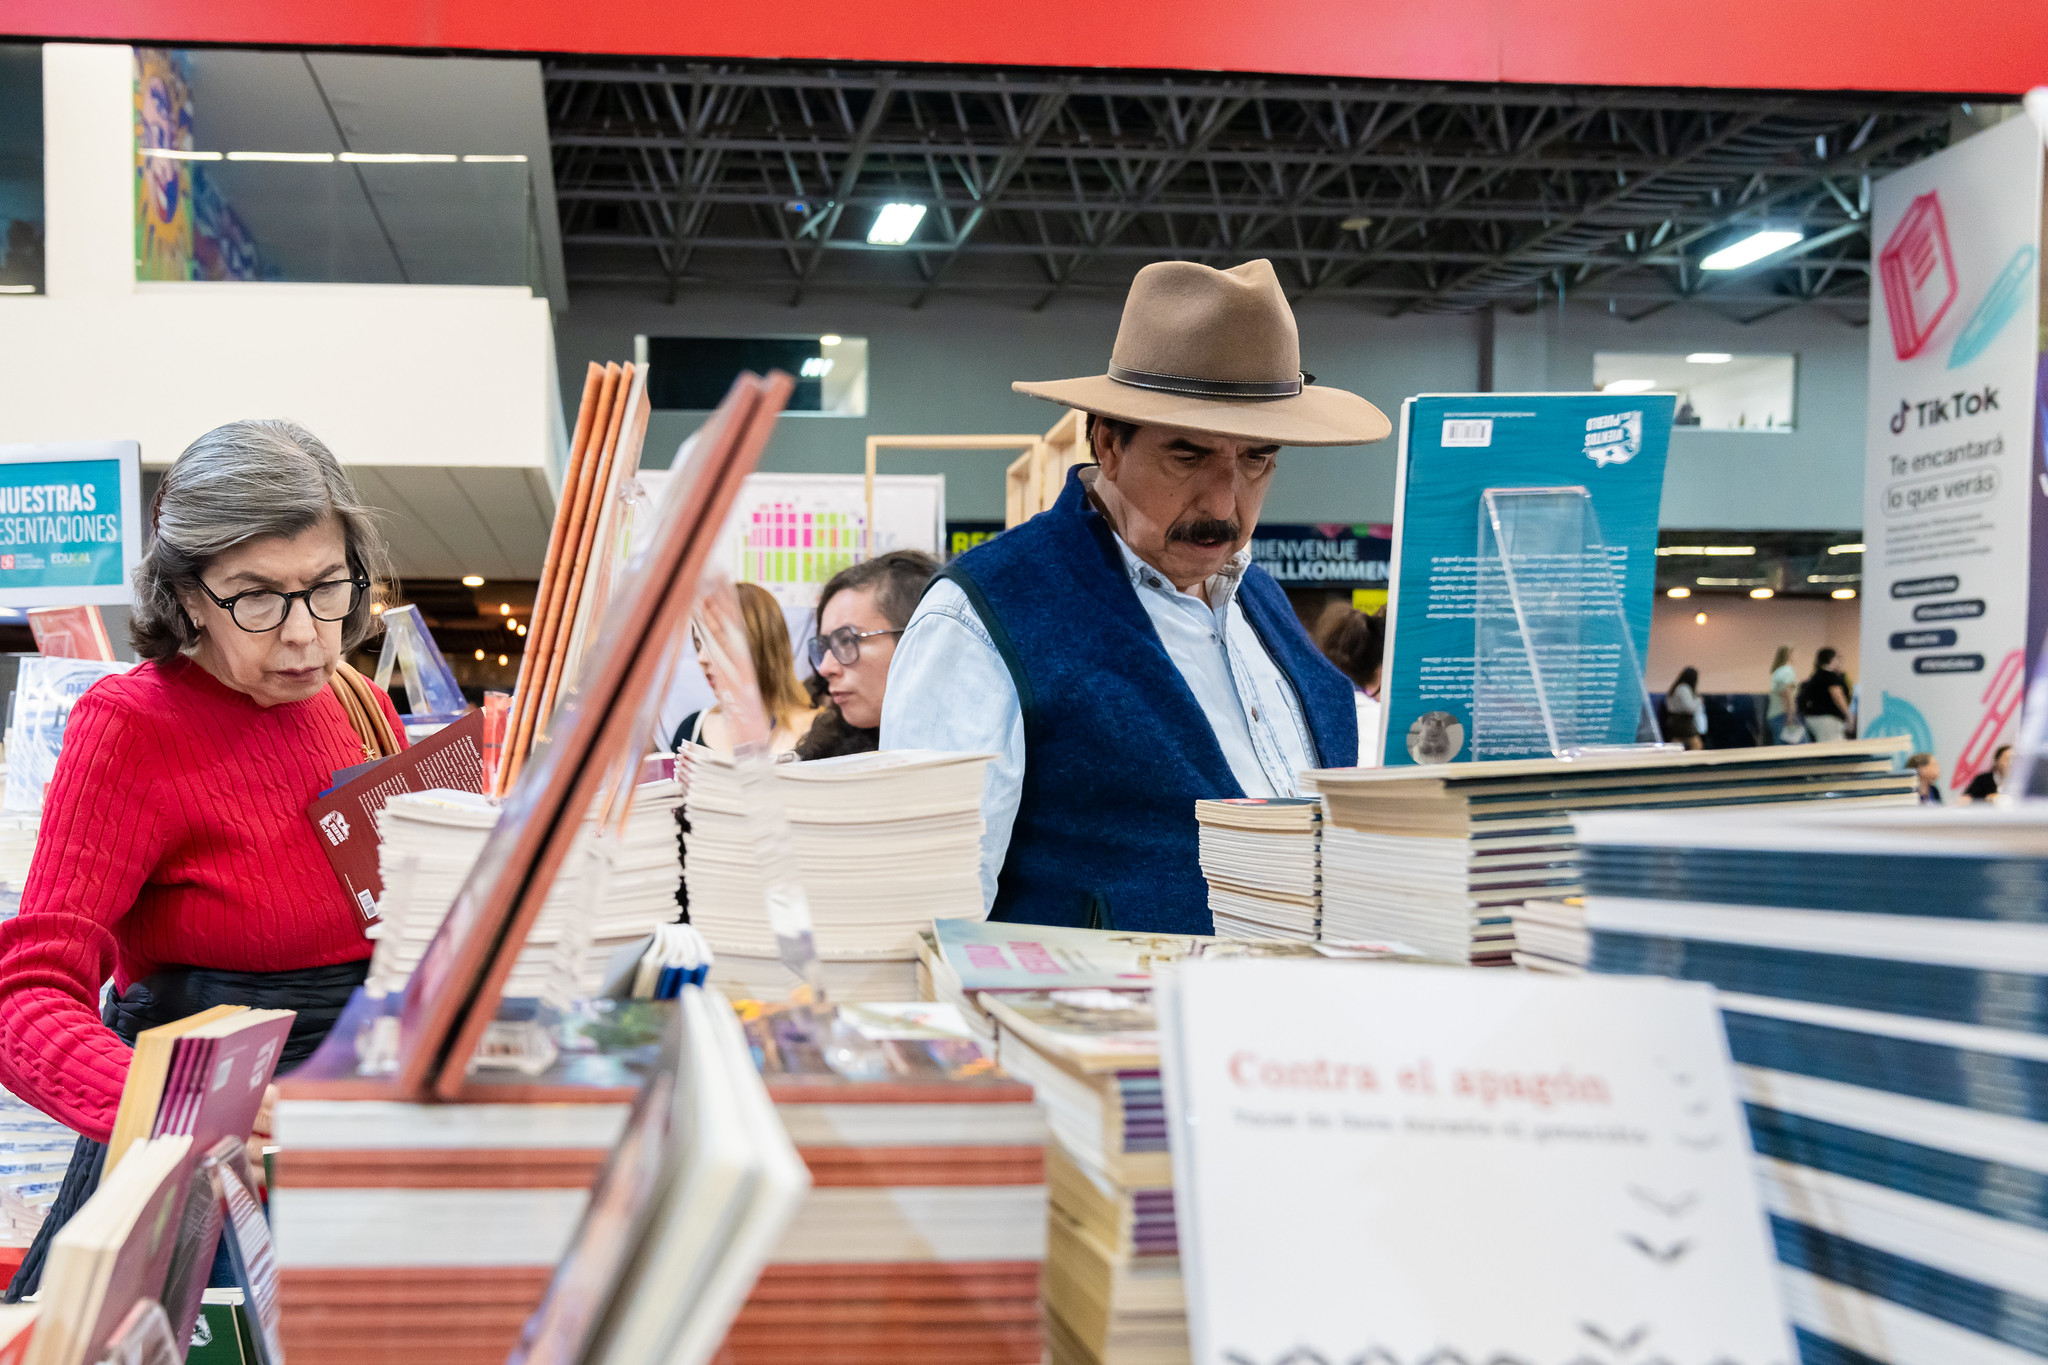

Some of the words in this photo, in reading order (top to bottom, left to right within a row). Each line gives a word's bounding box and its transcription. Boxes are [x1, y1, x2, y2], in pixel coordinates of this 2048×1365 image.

[1916, 385, 1999, 427] TikTok
[1890, 455, 1908, 475] Te
[1911, 434, 2004, 471] encantará
[1887, 489, 1902, 509] lo
[1906, 485, 1939, 510] que
[1944, 474, 1995, 498] verás
[1251, 539, 1358, 561] BIENVENUE
[1227, 1049, 1381, 1093] Contra
[1397, 1057, 1435, 1095] el
[1452, 1064, 1613, 1110] apagón
